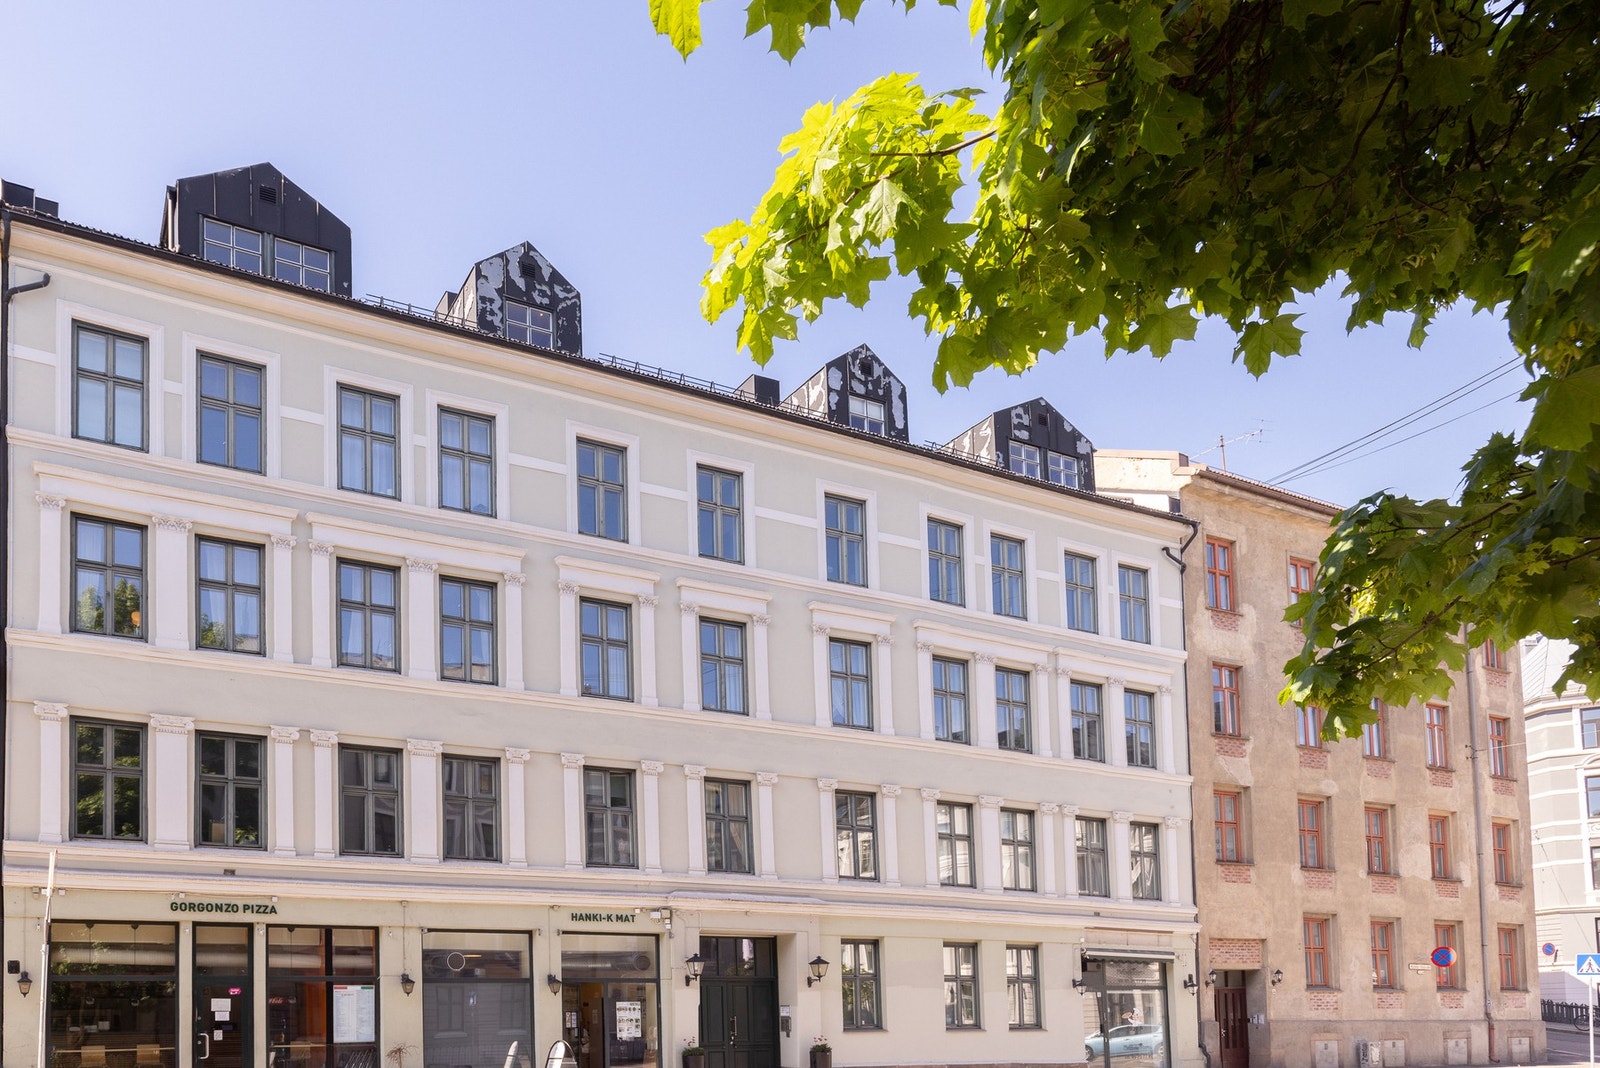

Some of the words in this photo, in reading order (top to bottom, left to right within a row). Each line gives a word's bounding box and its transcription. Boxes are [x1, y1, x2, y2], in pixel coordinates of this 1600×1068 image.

[170, 902, 239, 913] GORGONZO
[243, 904, 277, 914] PIZZA
[571, 913, 613, 922] HANKI-K
[616, 914, 636, 923] MAT
